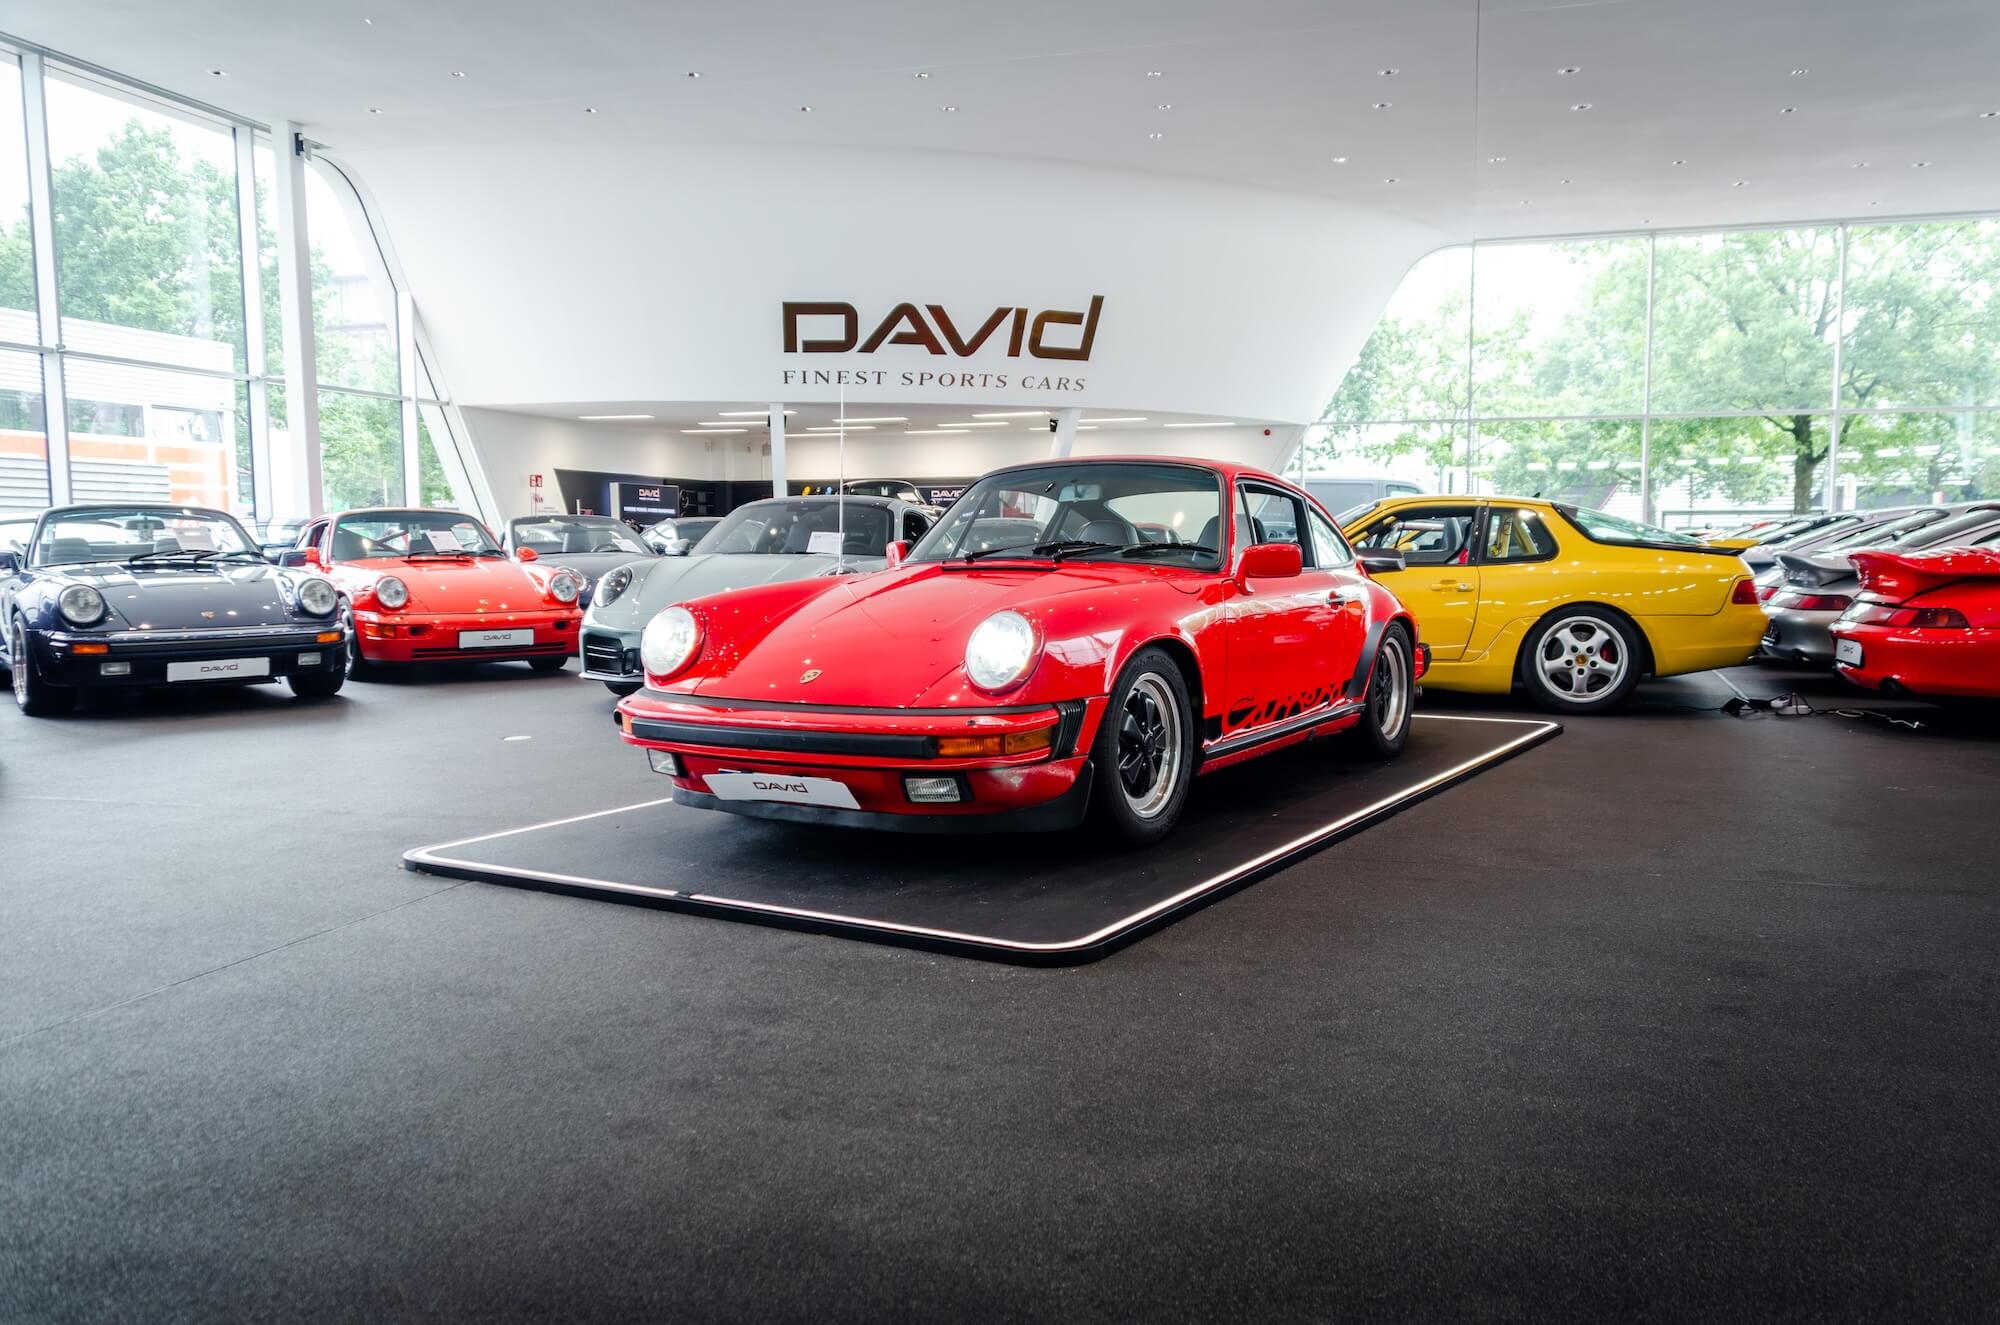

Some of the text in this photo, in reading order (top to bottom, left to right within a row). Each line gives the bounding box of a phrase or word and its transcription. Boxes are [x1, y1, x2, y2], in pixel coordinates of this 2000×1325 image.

[782, 370, 1086, 393] FINEST SPORTS CARS
